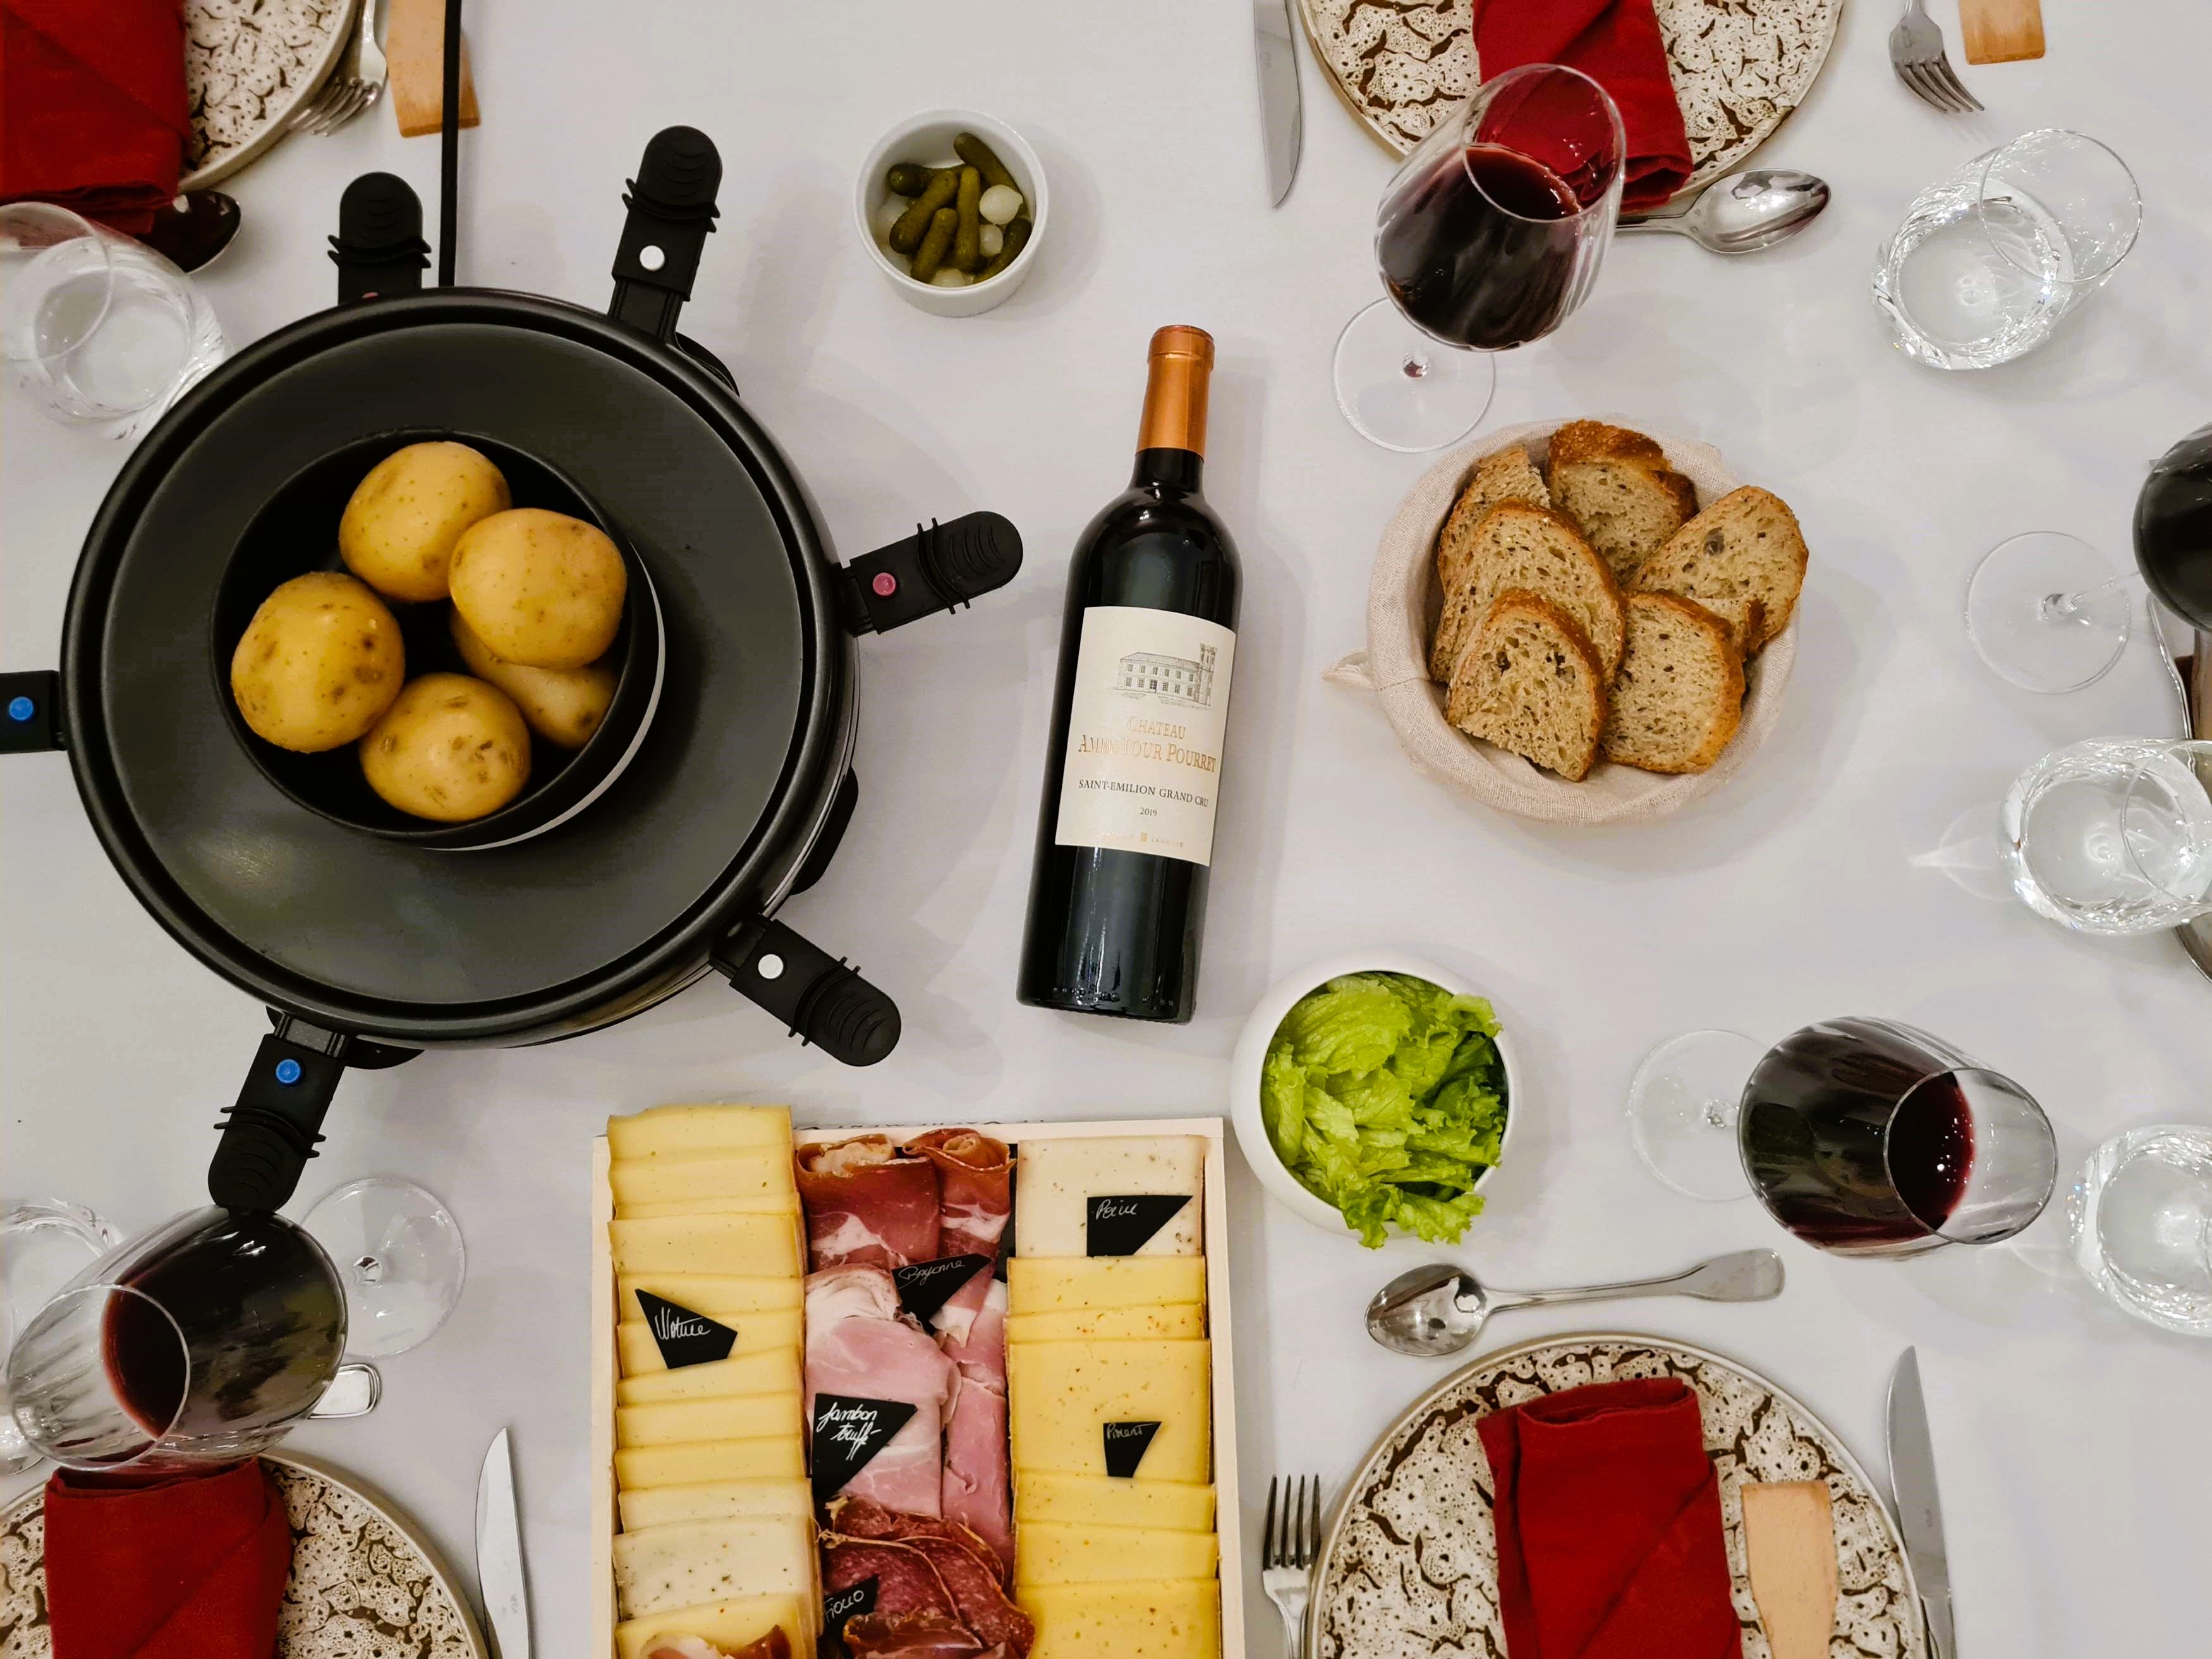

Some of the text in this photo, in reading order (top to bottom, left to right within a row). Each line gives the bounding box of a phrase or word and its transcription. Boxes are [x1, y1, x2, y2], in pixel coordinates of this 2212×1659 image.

[1166, 743, 1217, 772] POURRET
[1078, 779, 1209, 807] SAINT-EMILION GRAND CRU
[1139, 807, 1157, 817] 2019
[899, 1260, 965, 1289] Bayonne
[816, 1402, 877, 1432] Jambon
